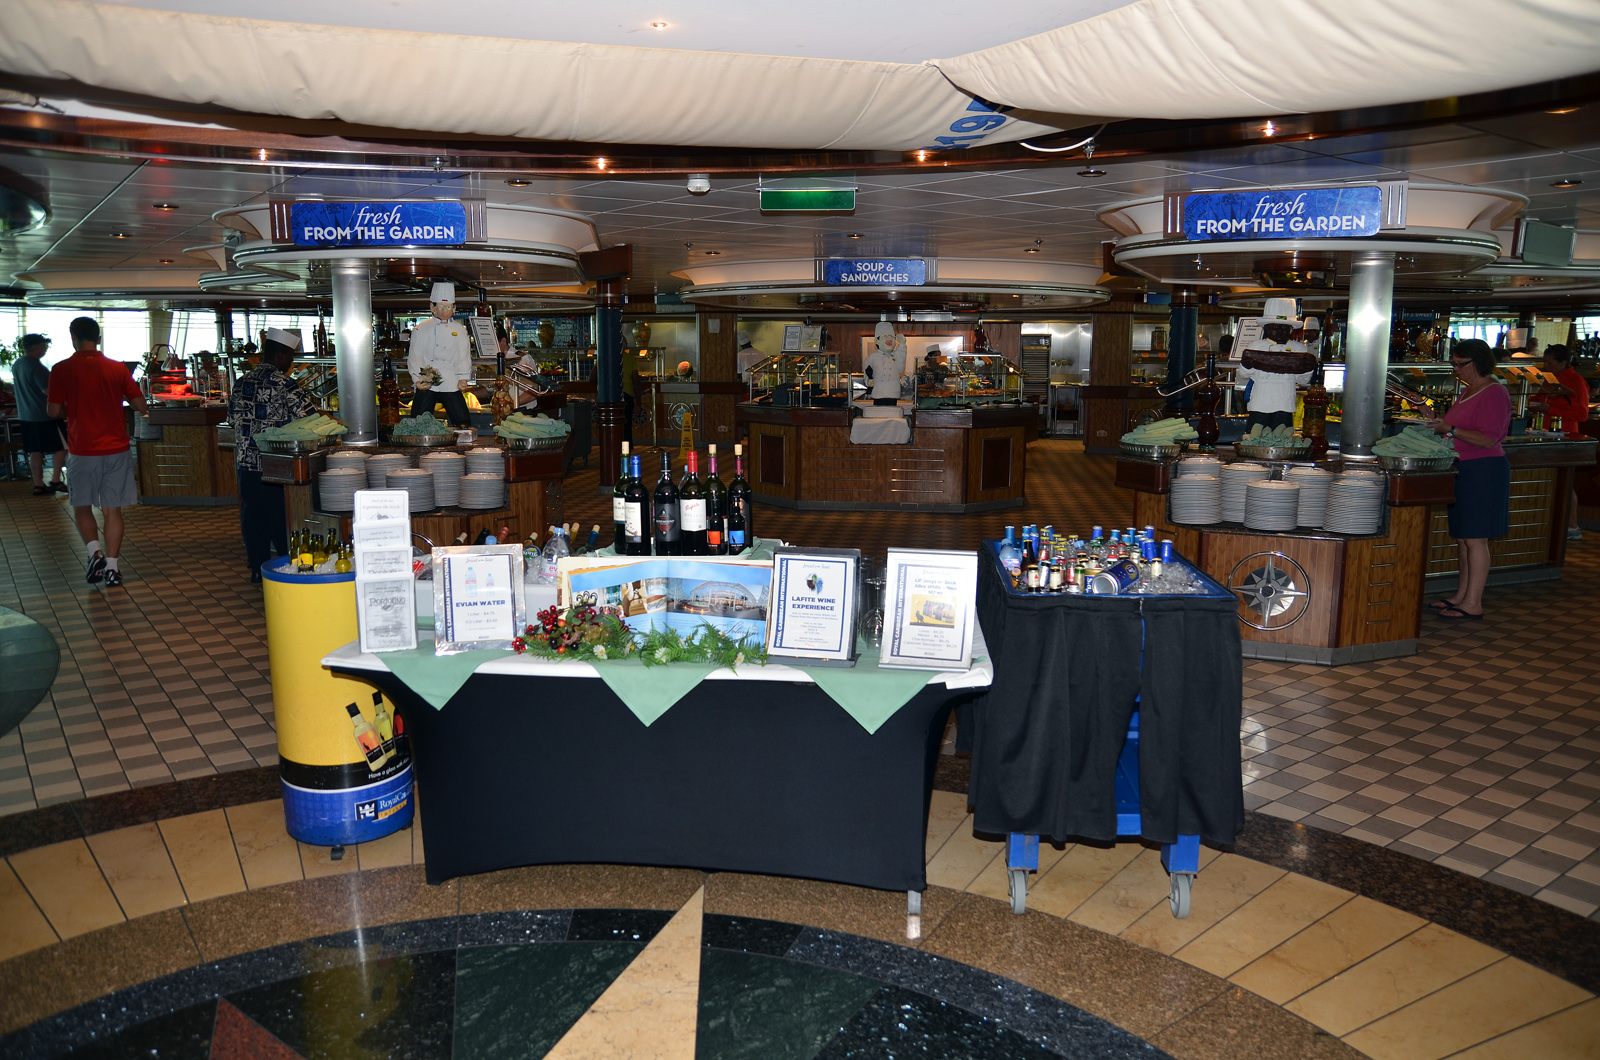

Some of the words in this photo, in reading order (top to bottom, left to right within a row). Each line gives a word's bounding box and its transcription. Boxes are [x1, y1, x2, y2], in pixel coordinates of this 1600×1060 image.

[1244, 193, 1307, 225] fresh
[348, 205, 402, 233] fresh
[1196, 219, 1246, 234] FROM
[1252, 218, 1284, 232] THE
[1290, 215, 1365, 231] GARDEN
[304, 227, 350, 240] FROM
[356, 226, 385, 240] THE
[390, 226, 454, 239] GARDEN
[856, 263, 884, 272] SOUP
[886, 263, 894, 272] &
[841, 273, 909, 282] SANDWICHES
